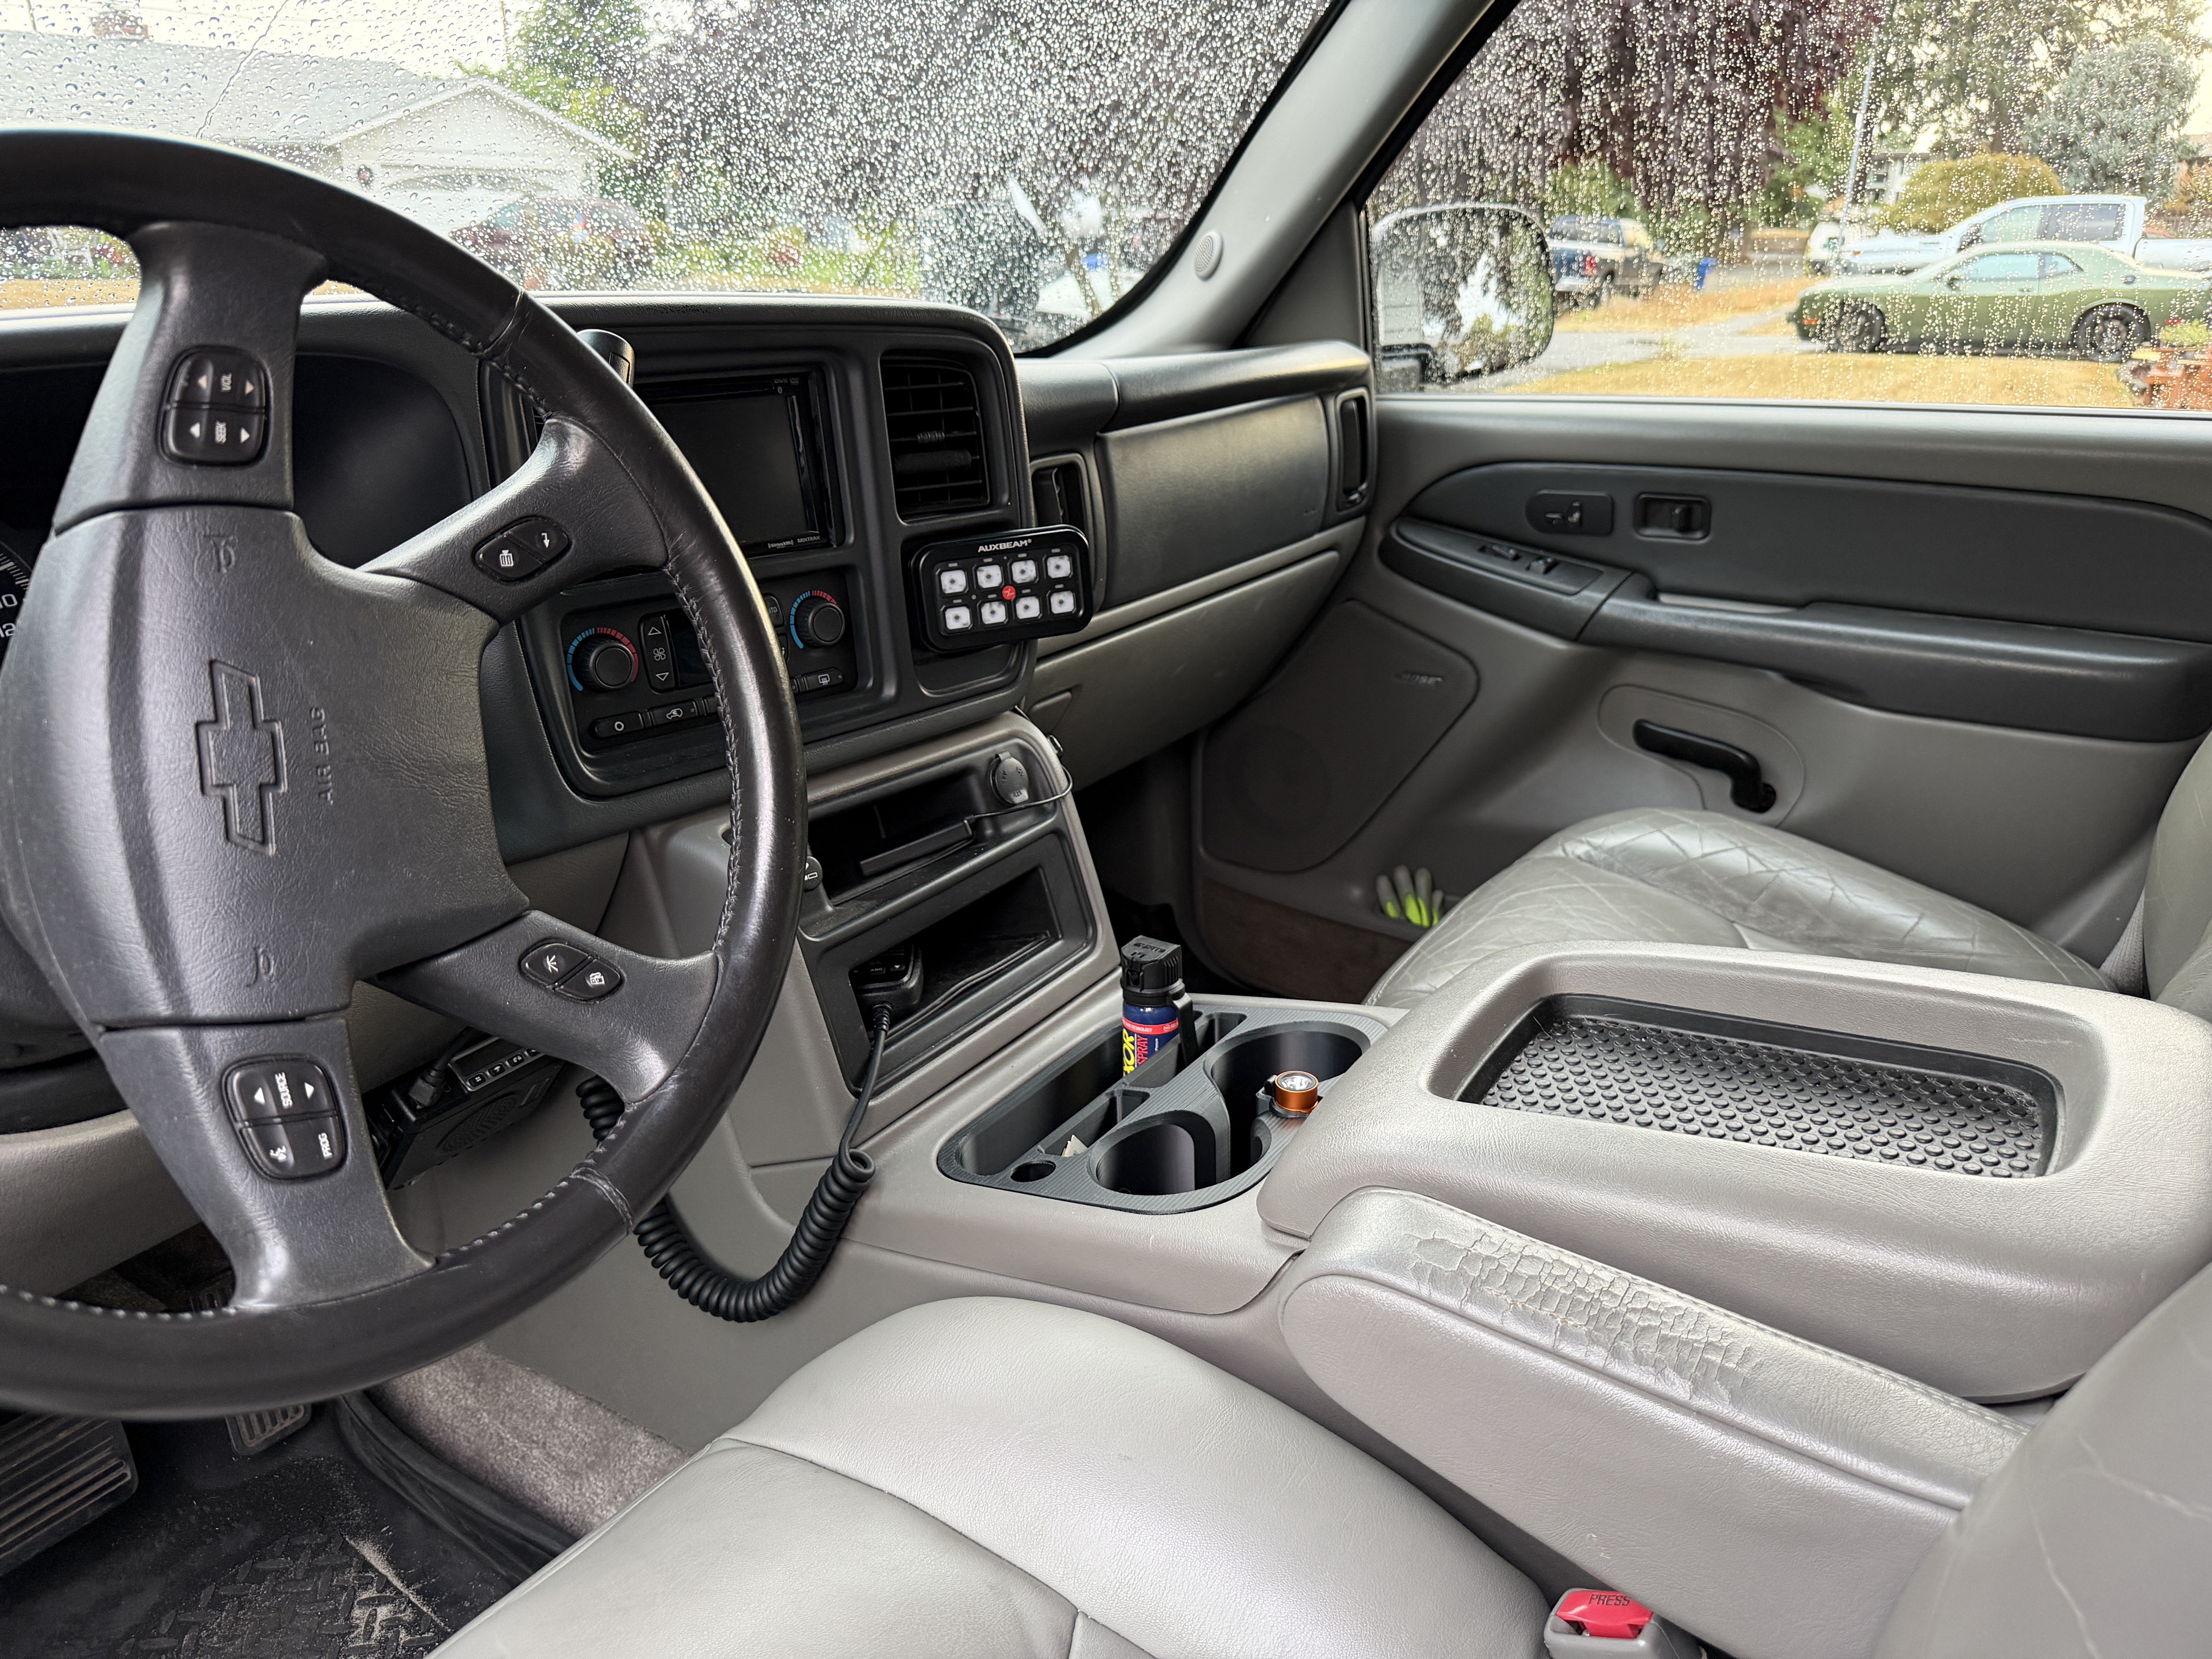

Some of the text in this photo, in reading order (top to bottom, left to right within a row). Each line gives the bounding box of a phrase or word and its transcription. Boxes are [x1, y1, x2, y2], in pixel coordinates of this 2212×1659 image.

[221, 373, 232, 391] VOL
[215, 420, 227, 444] SEEK
[309, 707, 329, 755] BAG
[1137, 1034, 1149, 1065] SPRAY
[275, 1072, 293, 1109] SOURCE
[318, 1133, 333, 1159] PROG
[1588, 1594, 1630, 1606] PRESS
